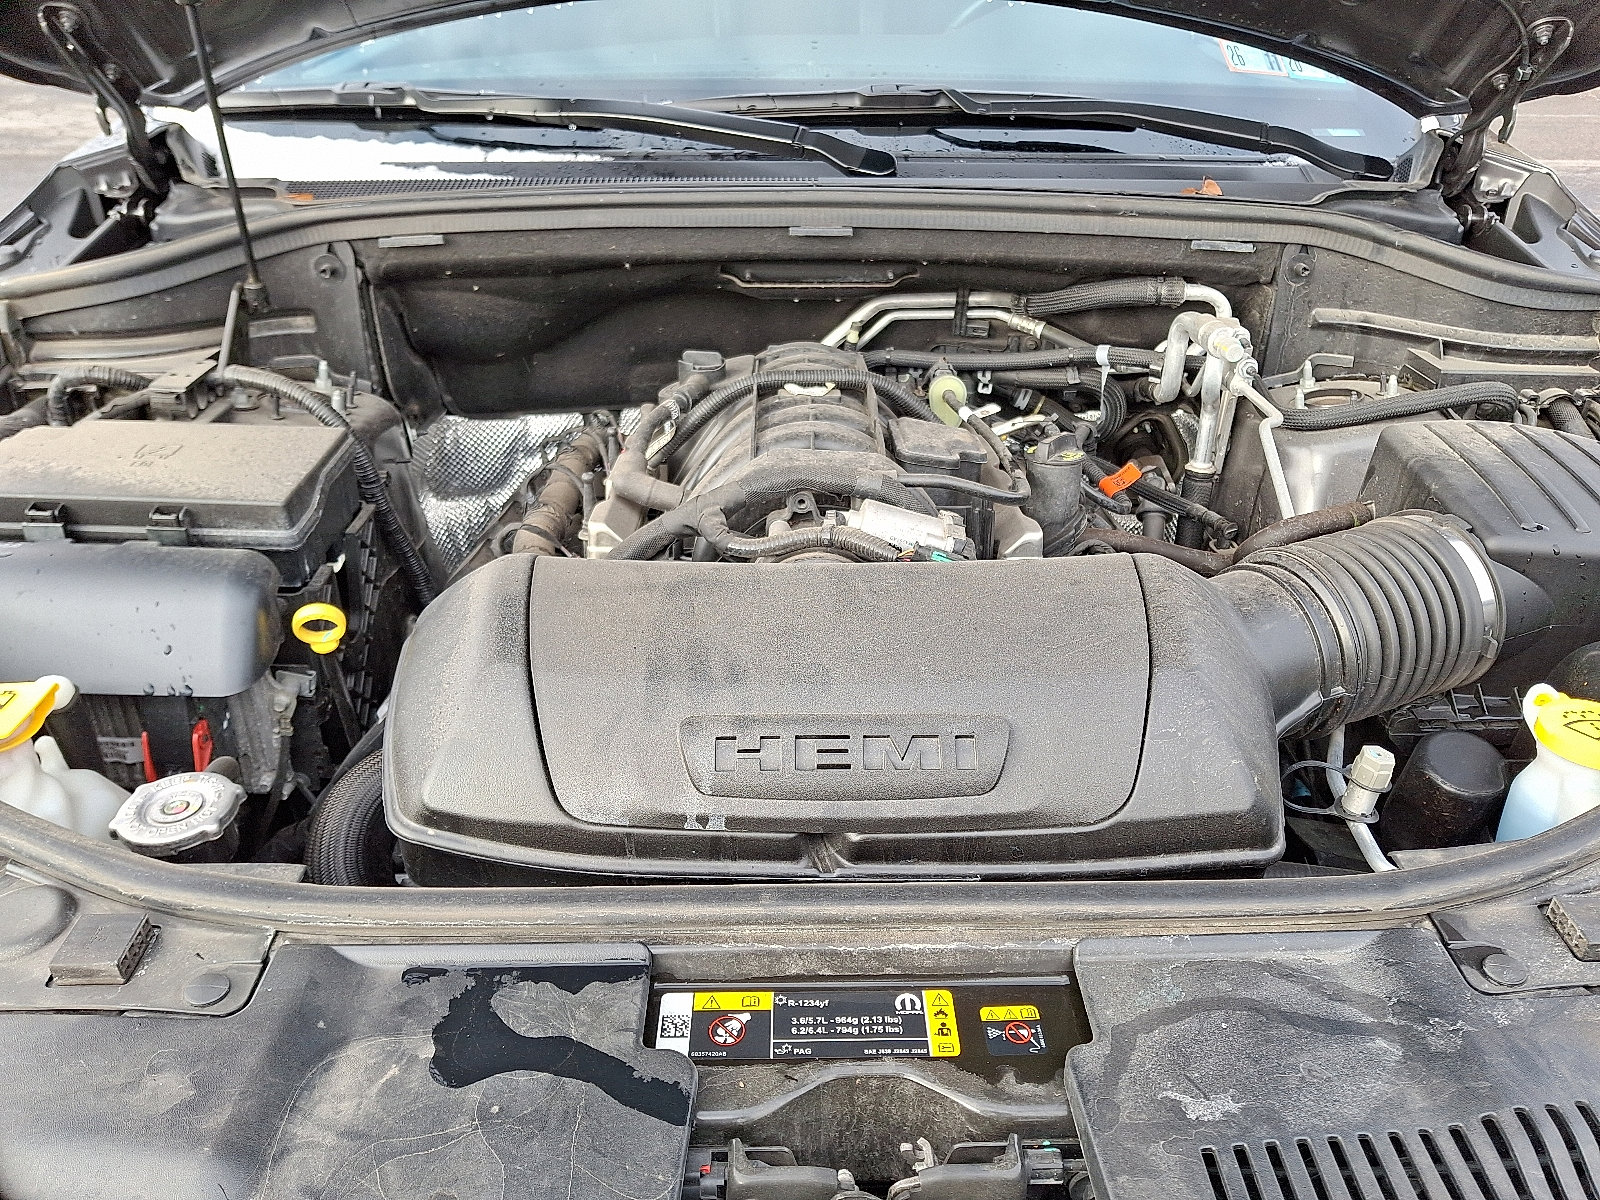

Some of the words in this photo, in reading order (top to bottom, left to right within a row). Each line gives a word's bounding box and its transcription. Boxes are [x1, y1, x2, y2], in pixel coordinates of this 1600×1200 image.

[1226, 45, 1246, 66] 26
[714, 734, 977, 772] HEMI
[787, 999, 829, 1007] R-1234yf
[791, 1017, 828, 1025] 3.6/5.7L
[835, 1016, 859, 1025] 964g
[860, 1016, 883, 1025] (2.13
[884, 1015, 903, 1024] lbs)
[791, 1026, 828, 1035] 6.2/6.4L
[835, 1026, 859, 1035] 794g
[861, 1025, 884, 1035] (1.75
[885, 1025, 904, 1034] lbs)
